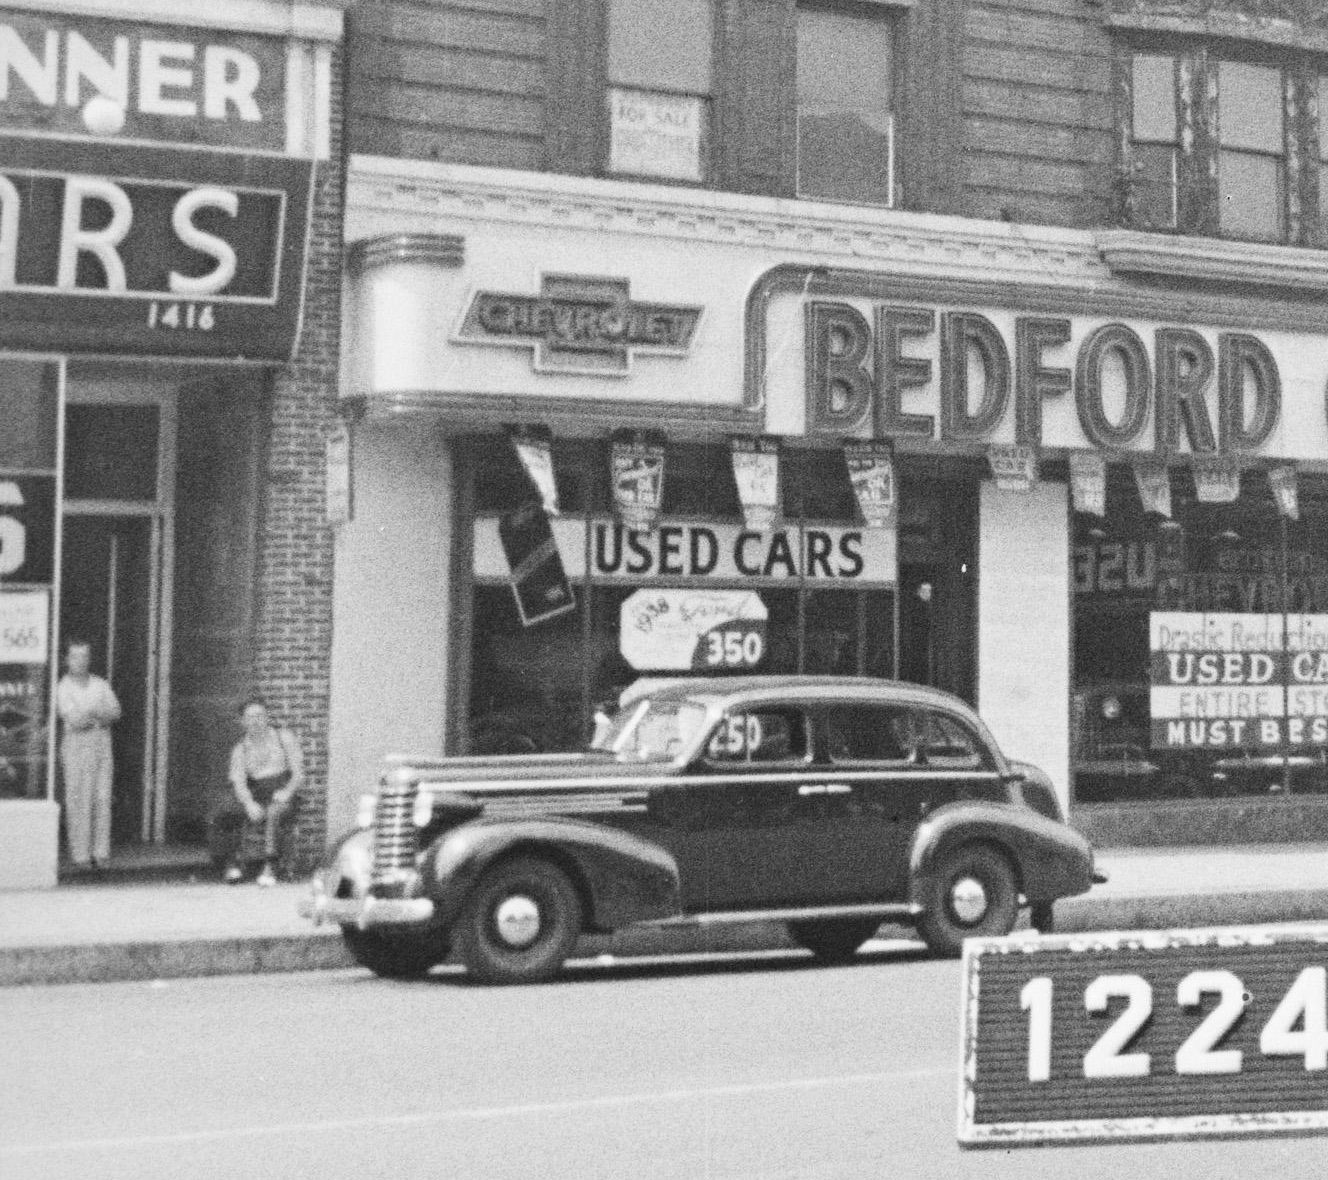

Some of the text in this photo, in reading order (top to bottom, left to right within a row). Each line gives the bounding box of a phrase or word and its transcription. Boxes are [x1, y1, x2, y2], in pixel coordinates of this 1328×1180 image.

[148, 301, 216, 330] 1416
[478, 303, 698, 348] CHEVROLET
[804, 300, 1283, 458] BEDFORD
[595, 526, 865, 578] USED CARS
[706, 630, 763, 665] 350
[1167, 652, 1276, 684] USED
[1178, 691, 1269, 718] ENTIRE
[1168, 720, 1246, 746] MUST
[1261, 719, 1304, 745] BE
